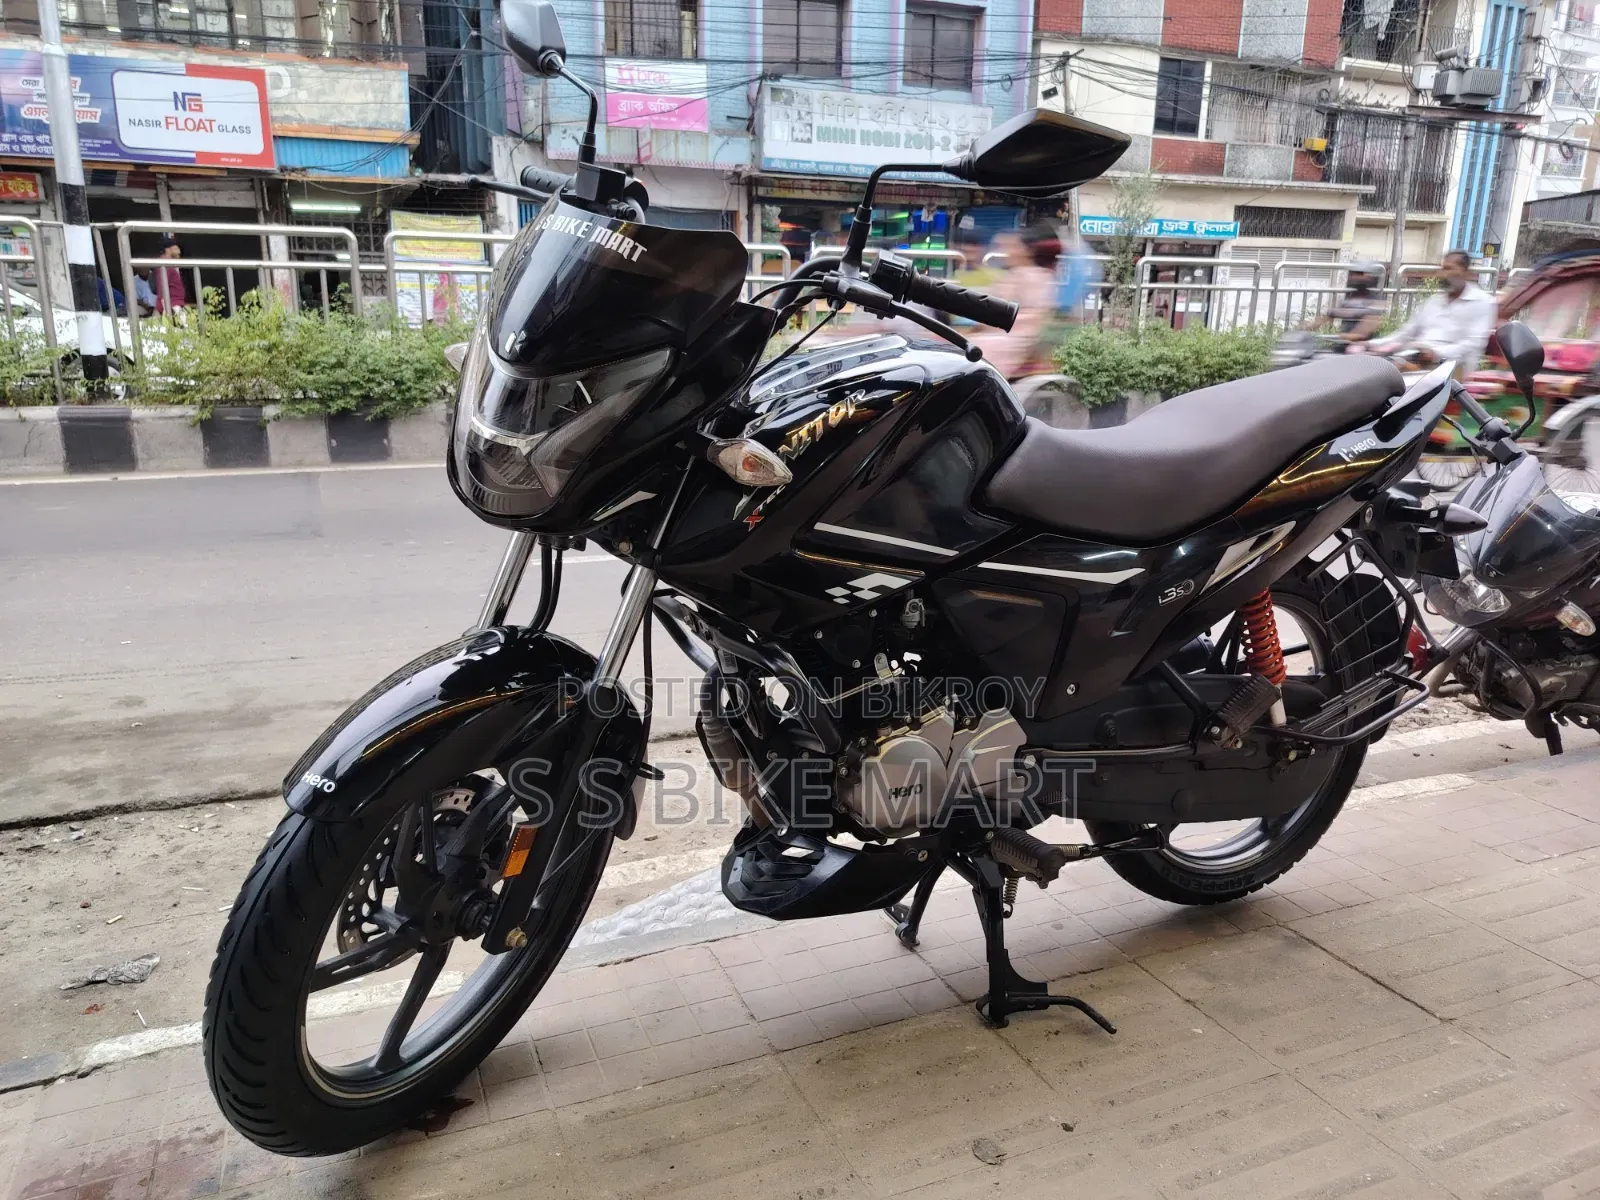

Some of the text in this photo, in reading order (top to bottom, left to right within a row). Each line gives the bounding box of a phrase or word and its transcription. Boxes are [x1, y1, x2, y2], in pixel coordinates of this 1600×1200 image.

[173, 91, 204, 113] NG
[128, 115, 252, 135] NASIR FLOAT GLASS
[816, 125, 952, 151] MINI HOBI ZOO-2
[552, 215, 593, 238] BIKE
[588, 225, 648, 263] MART
[1350, 437, 1377, 455] Hero
[301, 771, 336, 793] Hero
[888, 783, 924, 800] Hero
